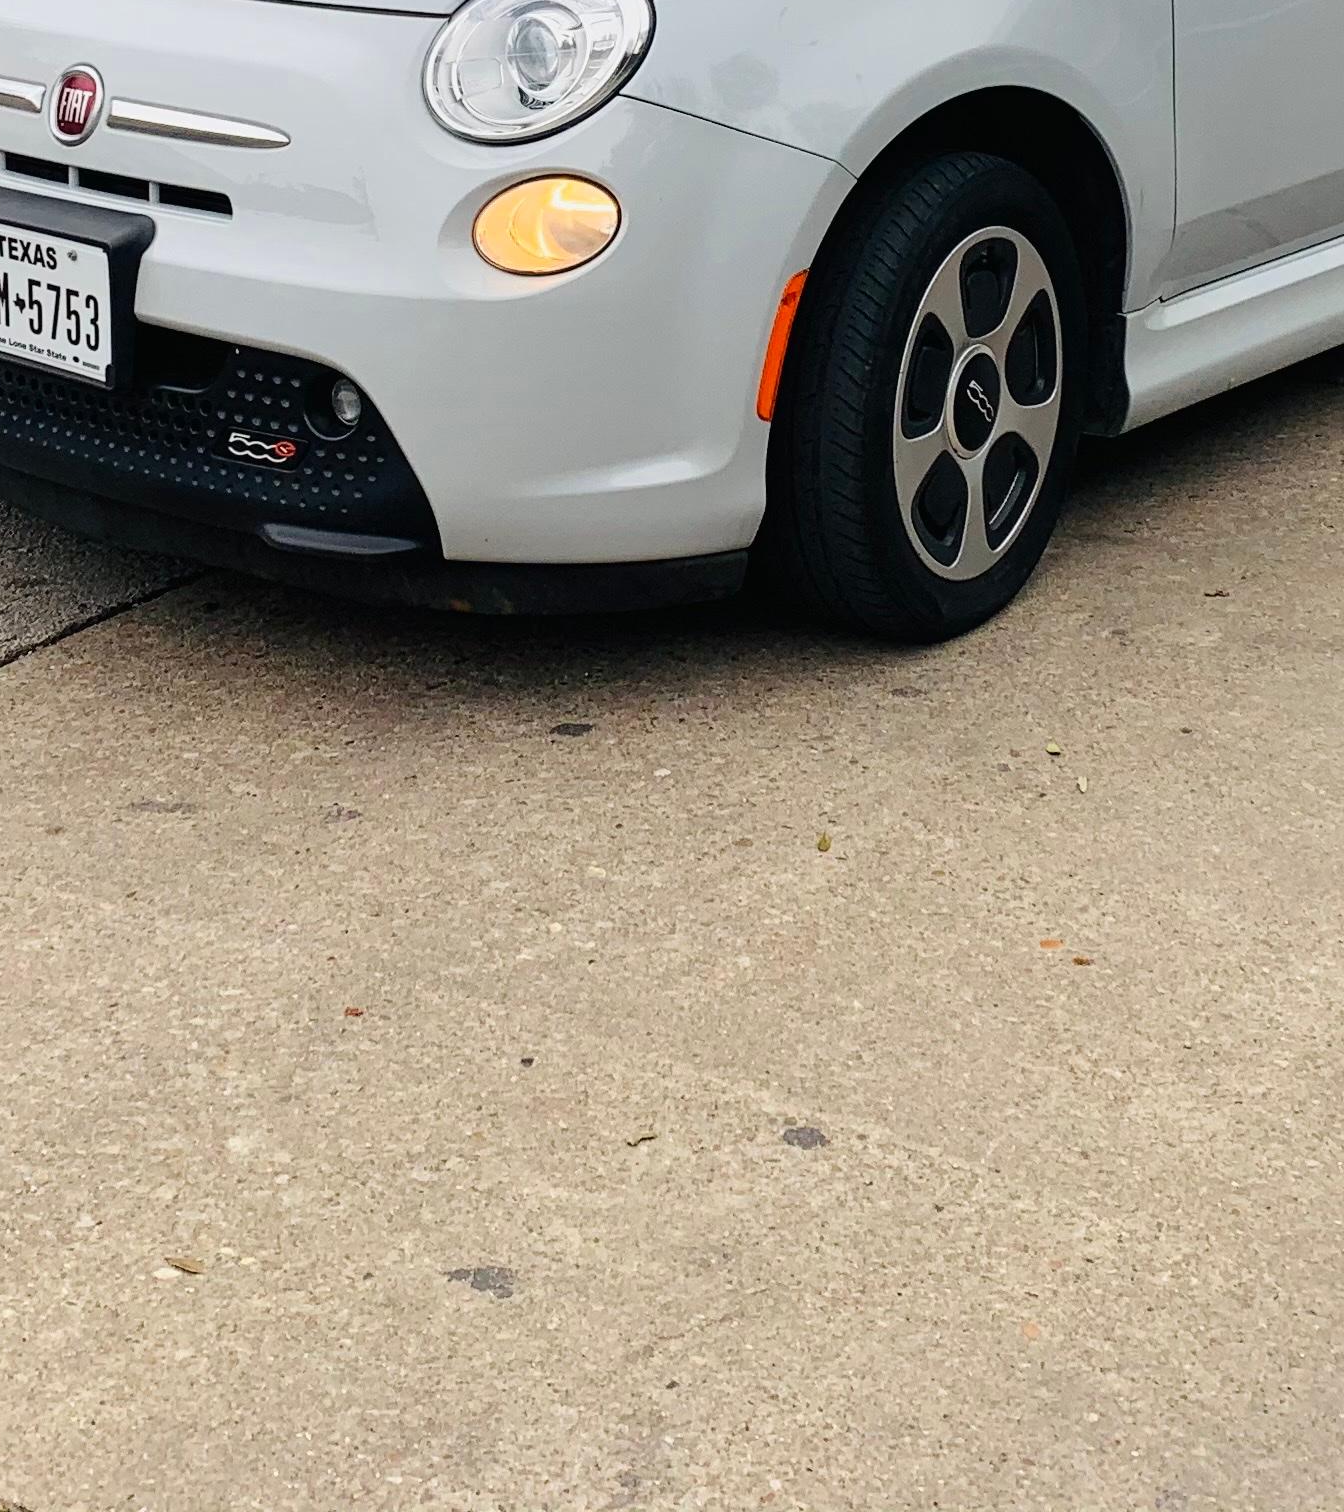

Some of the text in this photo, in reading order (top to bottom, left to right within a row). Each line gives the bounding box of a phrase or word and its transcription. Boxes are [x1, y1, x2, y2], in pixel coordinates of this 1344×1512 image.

[58, 87, 94, 125] FIAT
[27, 277, 100, 352] 5753
[8, 337, 27, 350] Lone
[28, 343, 46, 355] Star
[46, 348, 67, 362] State
[966, 379, 995, 423] 500
